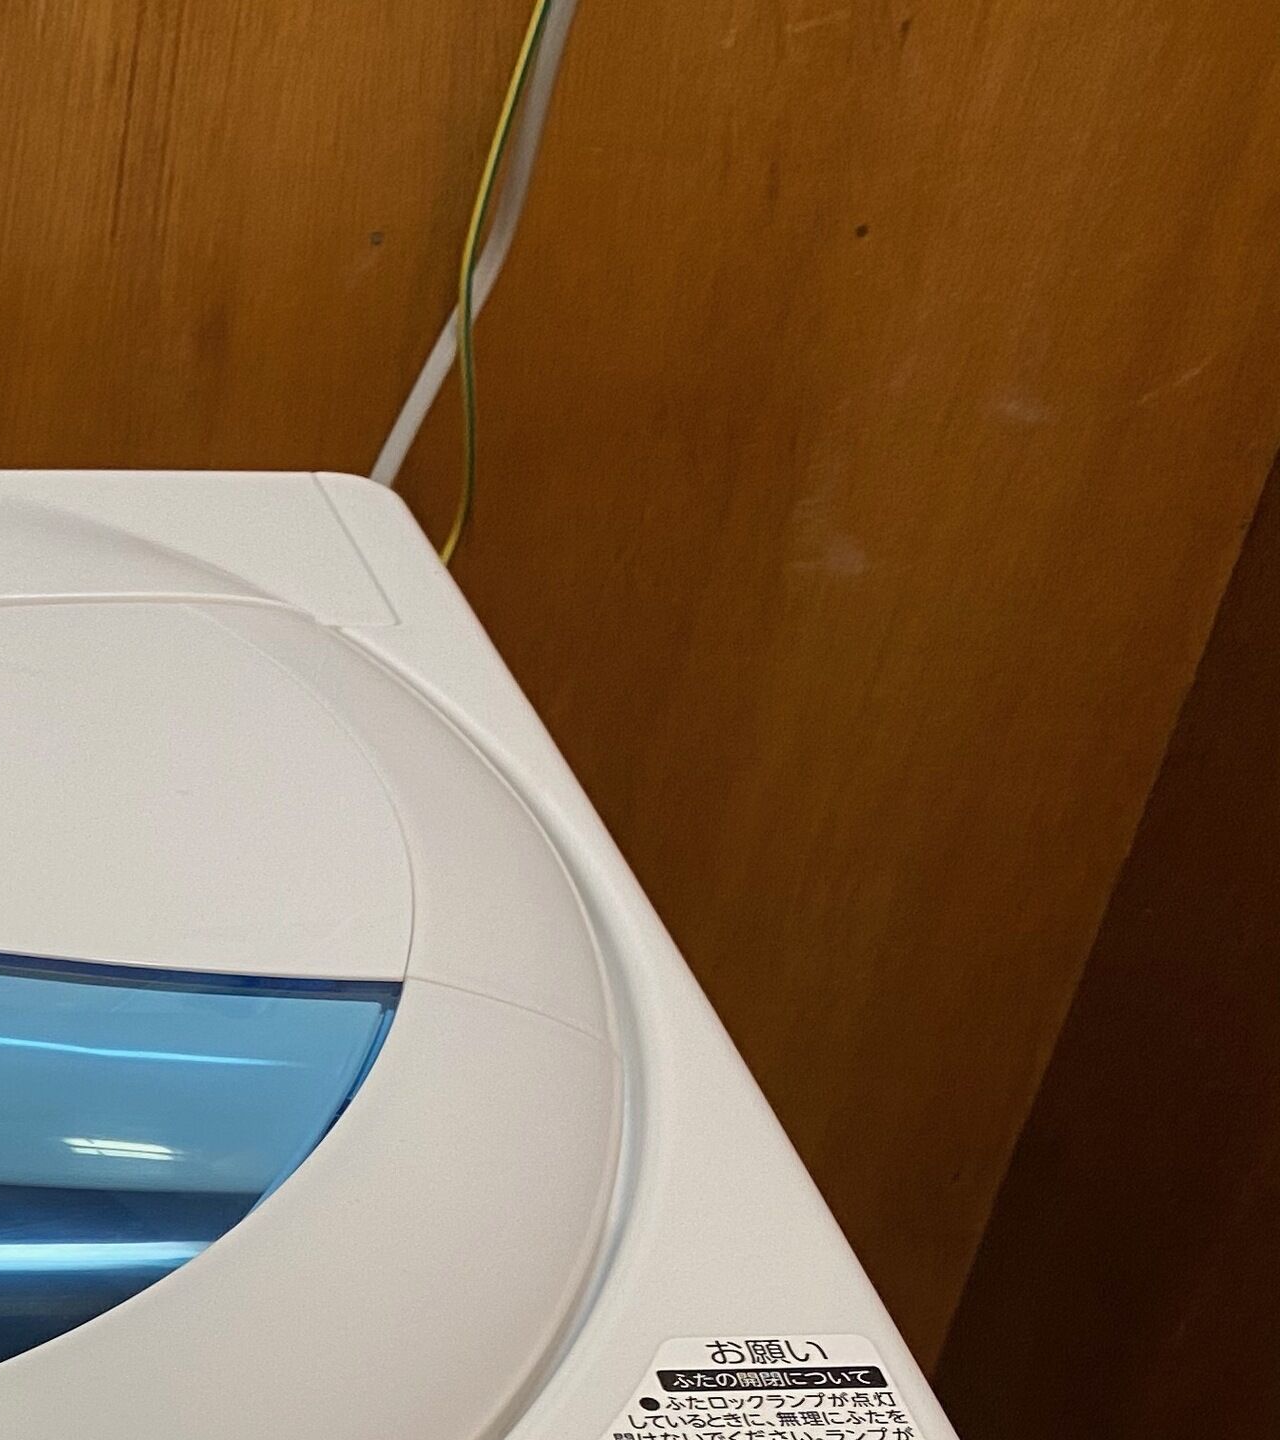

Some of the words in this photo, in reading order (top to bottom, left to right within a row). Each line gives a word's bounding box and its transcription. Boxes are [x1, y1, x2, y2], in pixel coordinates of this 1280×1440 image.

[706, 1340, 829, 1365] お願い
[672, 1370, 871, 1388] ふたの開閉について
[628, 1410, 909, 1429] しているときに、無理にふたを
